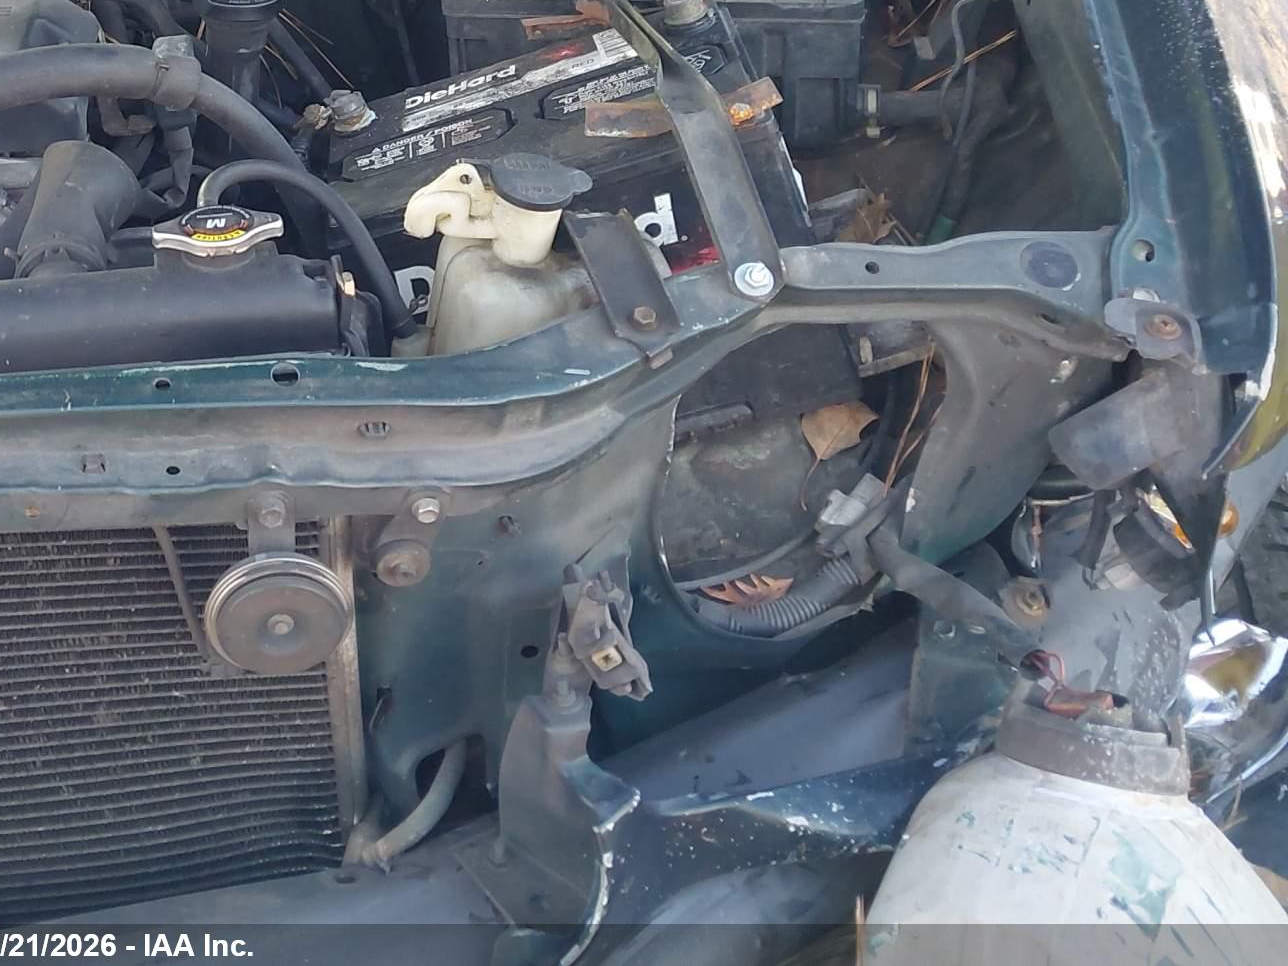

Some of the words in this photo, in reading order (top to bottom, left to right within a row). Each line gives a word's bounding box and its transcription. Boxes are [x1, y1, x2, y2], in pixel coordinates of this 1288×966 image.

[403, 64, 517, 110] DieHard
[381, 134, 424, 151] DANGER
[434, 118, 474, 135] POISON
